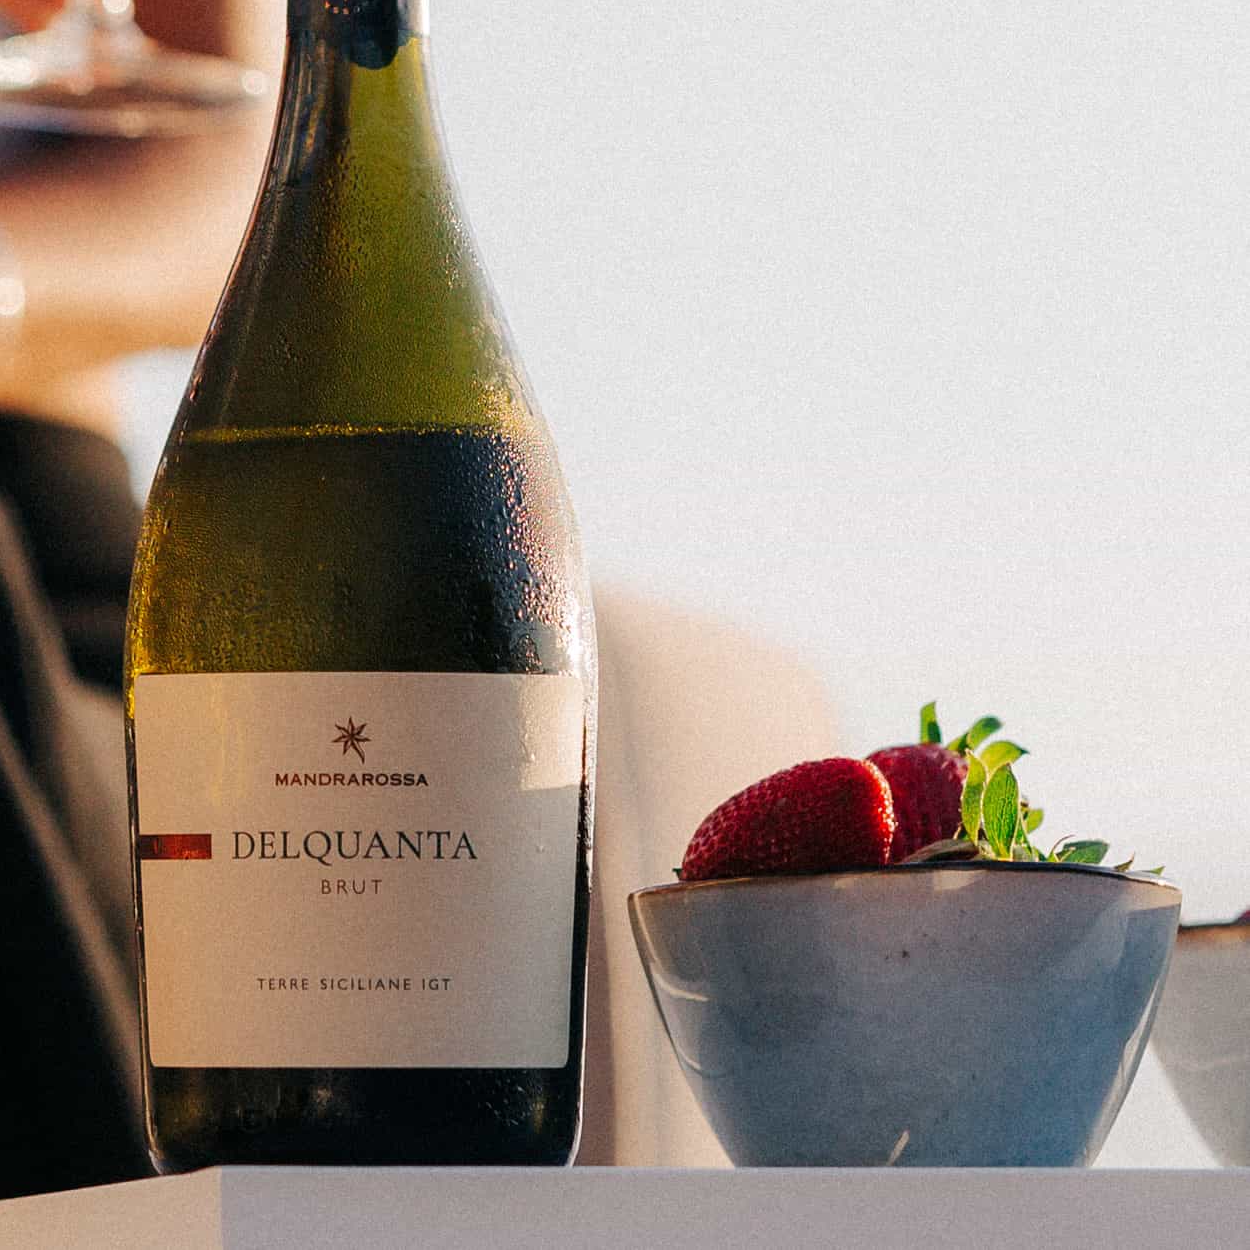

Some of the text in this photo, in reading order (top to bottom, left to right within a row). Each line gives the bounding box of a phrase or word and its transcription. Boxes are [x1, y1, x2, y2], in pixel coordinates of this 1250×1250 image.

[274, 772, 429, 787] MANDRAROSSA
[231, 830, 478, 867] DELQUANTA
[320, 878, 383, 895] BRUT
[257, 977, 451, 991] TERRE SICILIANE IGT
